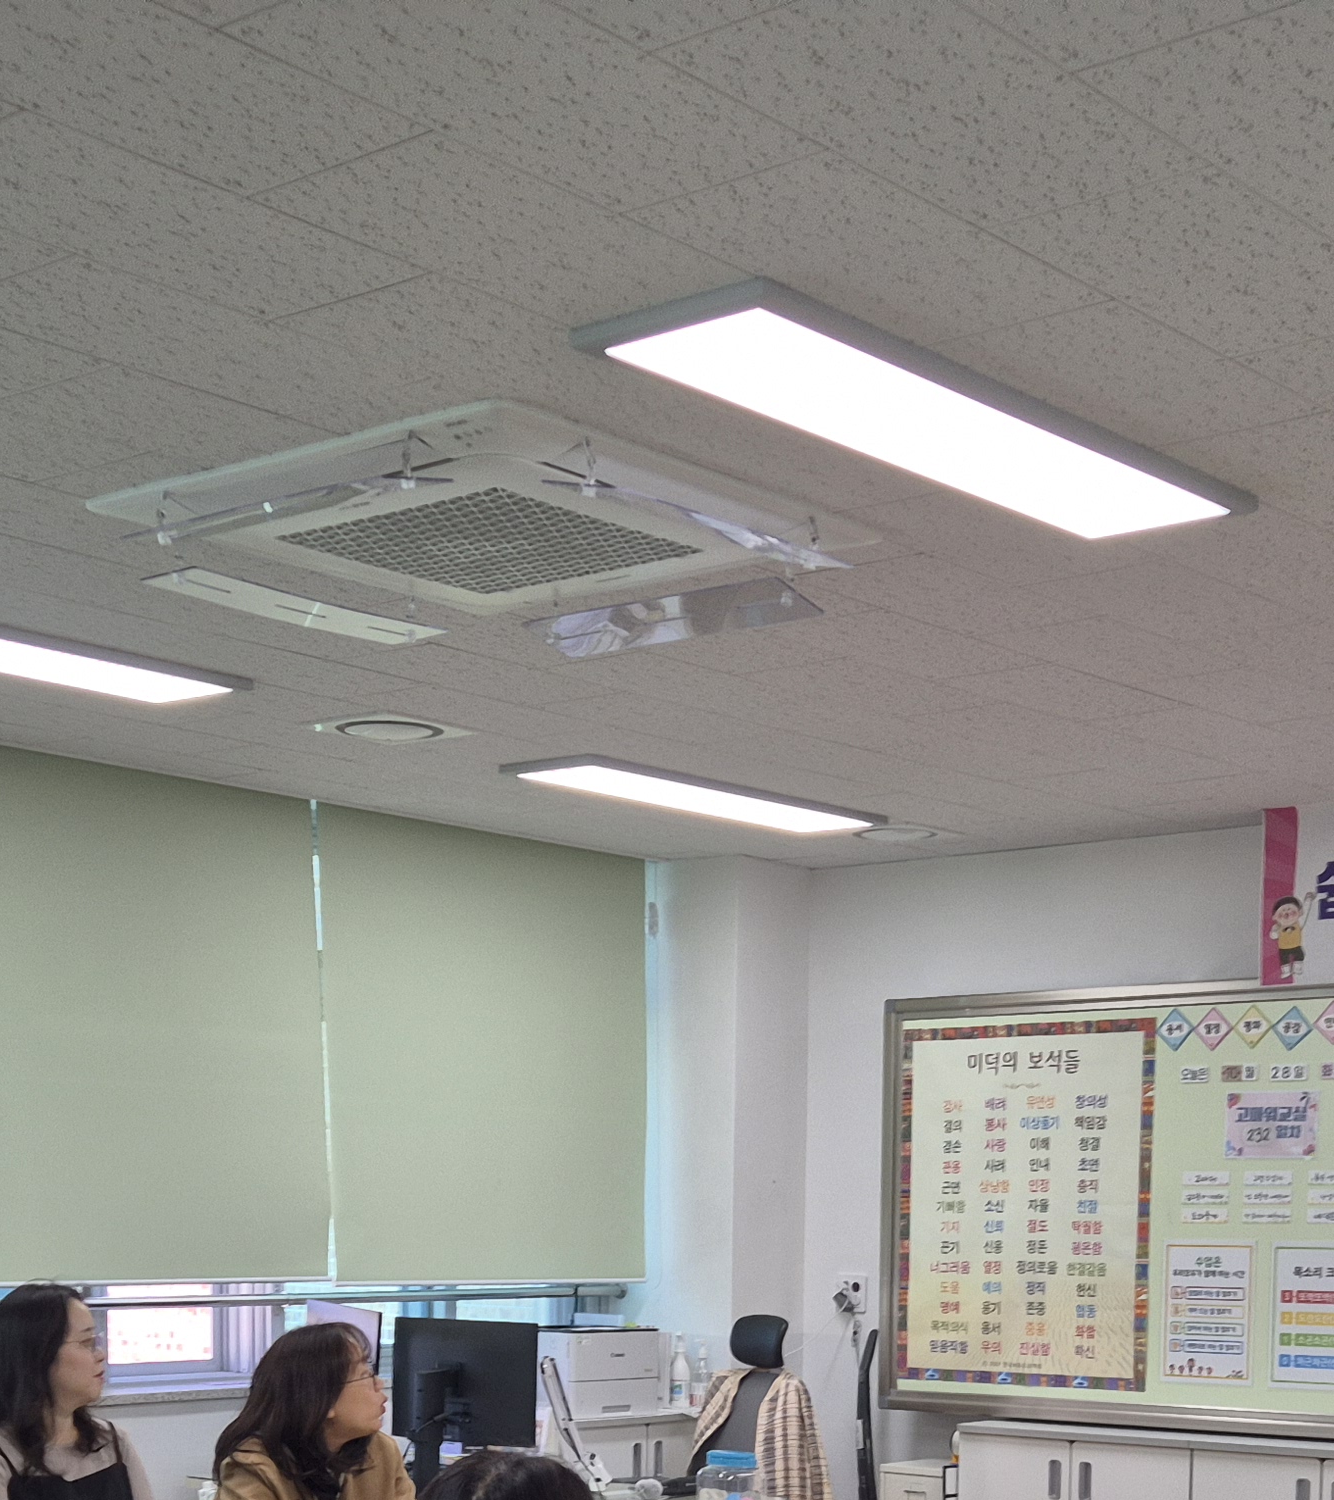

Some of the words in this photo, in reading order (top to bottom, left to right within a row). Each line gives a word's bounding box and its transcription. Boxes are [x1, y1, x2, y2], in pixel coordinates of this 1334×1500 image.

[967, 1051, 1018, 1075] 미덕의
[1028, 1050, 1081, 1074] 보석들
[1247, 1128, 1271, 1143] 232
[1293, 1266, 1322, 1278] 목소리
